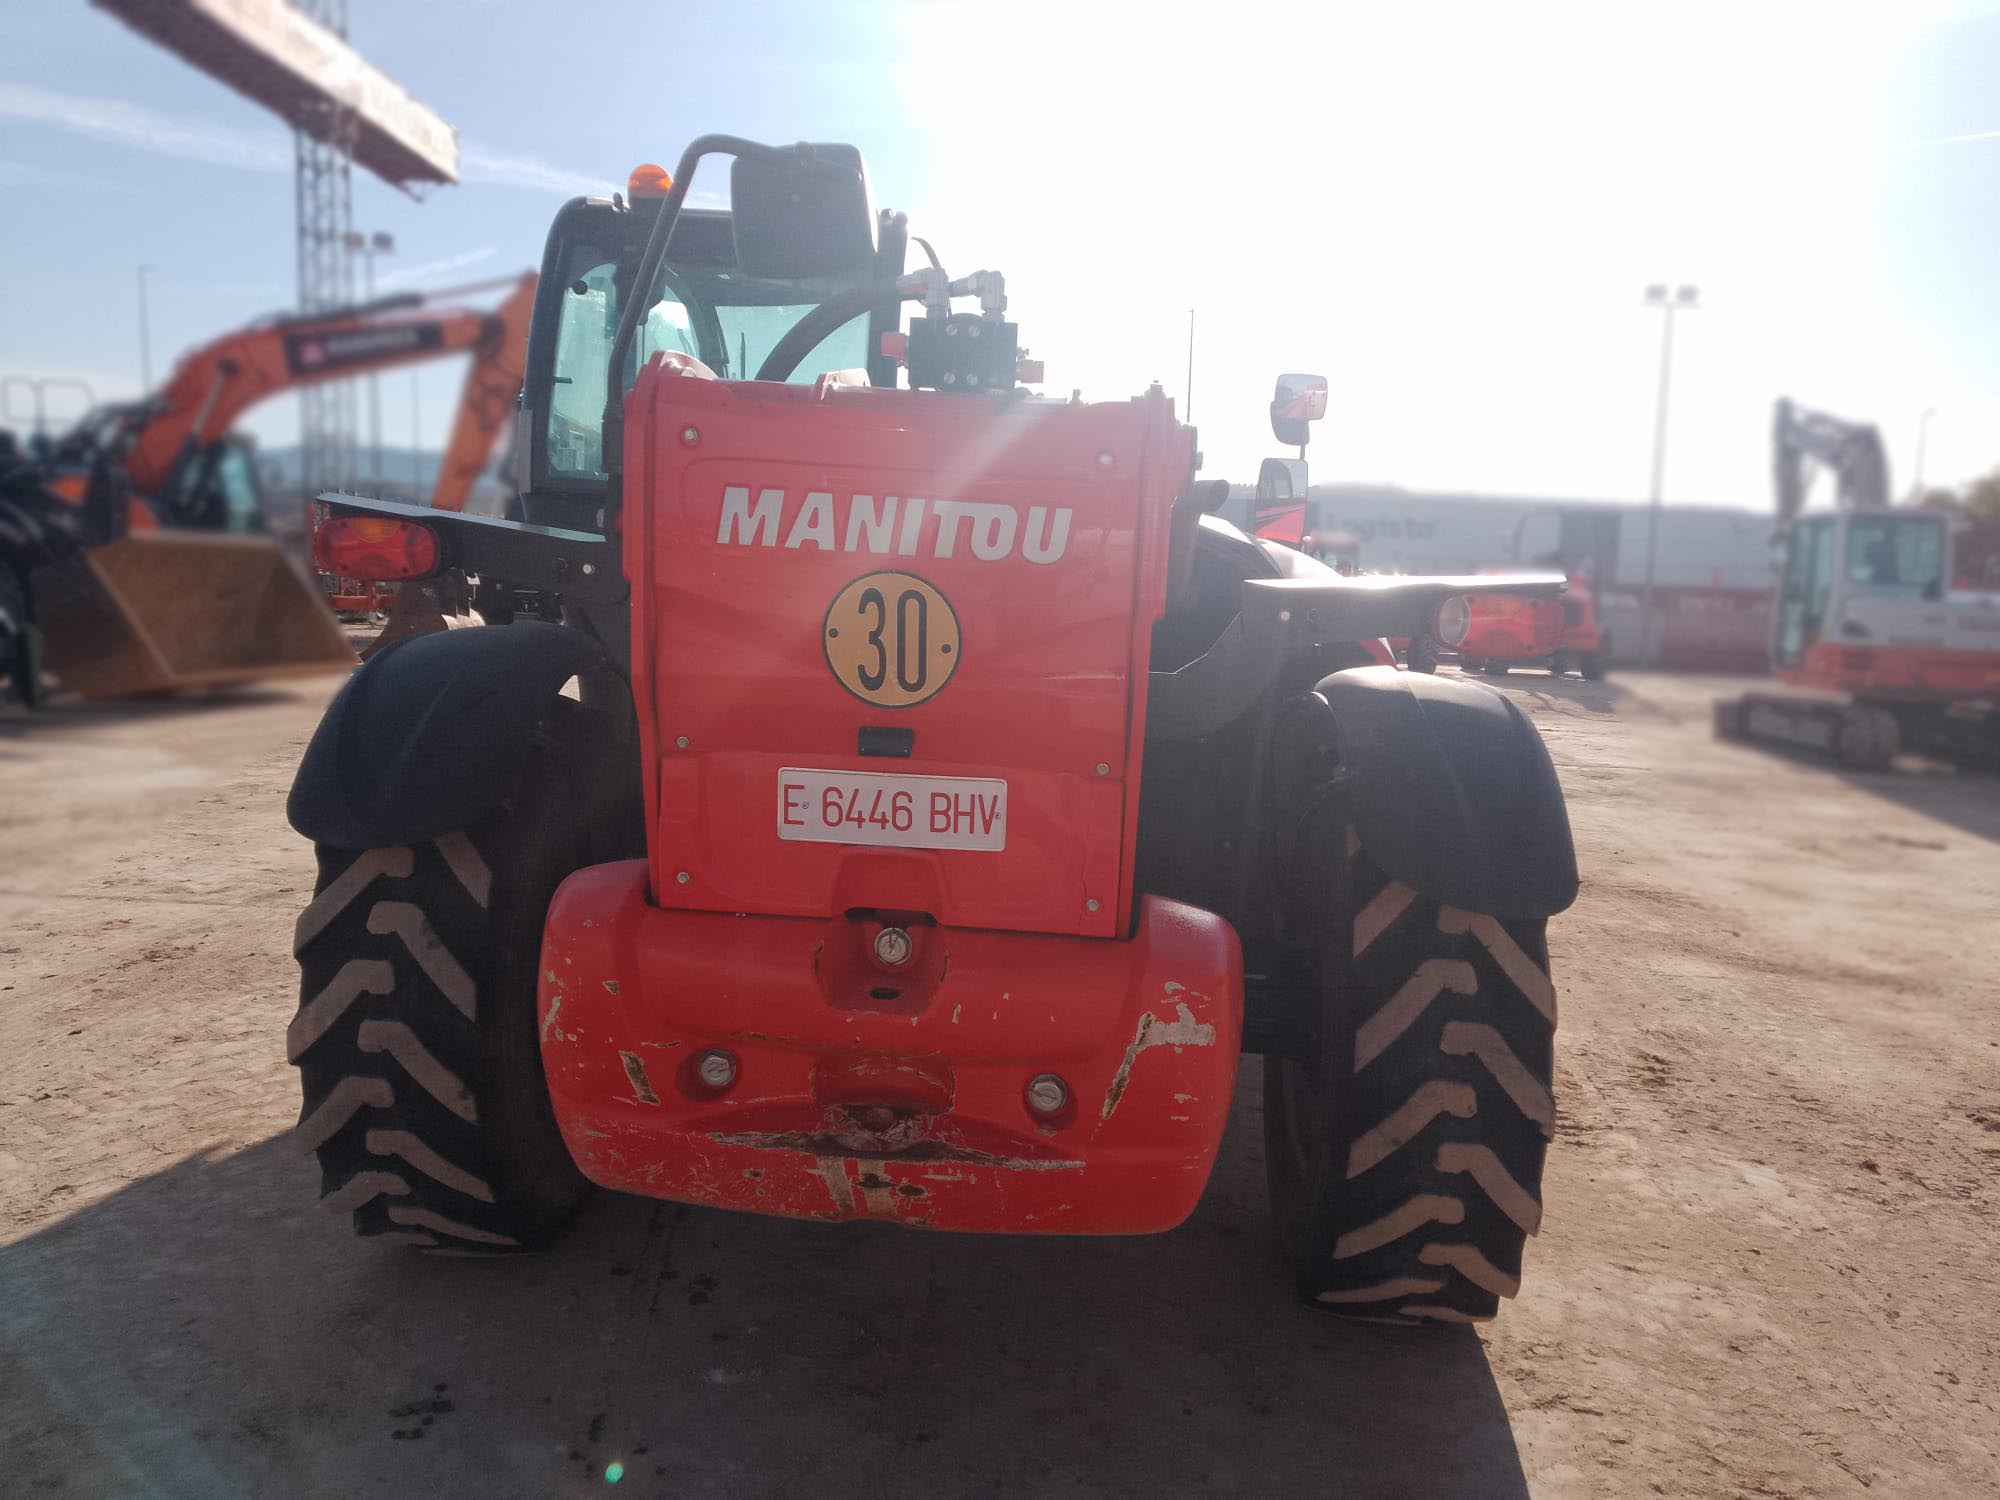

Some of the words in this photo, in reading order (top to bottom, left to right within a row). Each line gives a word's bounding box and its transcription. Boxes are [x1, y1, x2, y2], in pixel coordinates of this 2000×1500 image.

[716, 486, 1073, 565] MANITOU
[857, 587, 928, 693] 30
[783, 783, 805, 826] E
[821, 786, 913, 832] 6446
[929, 791, 999, 835] BHV
